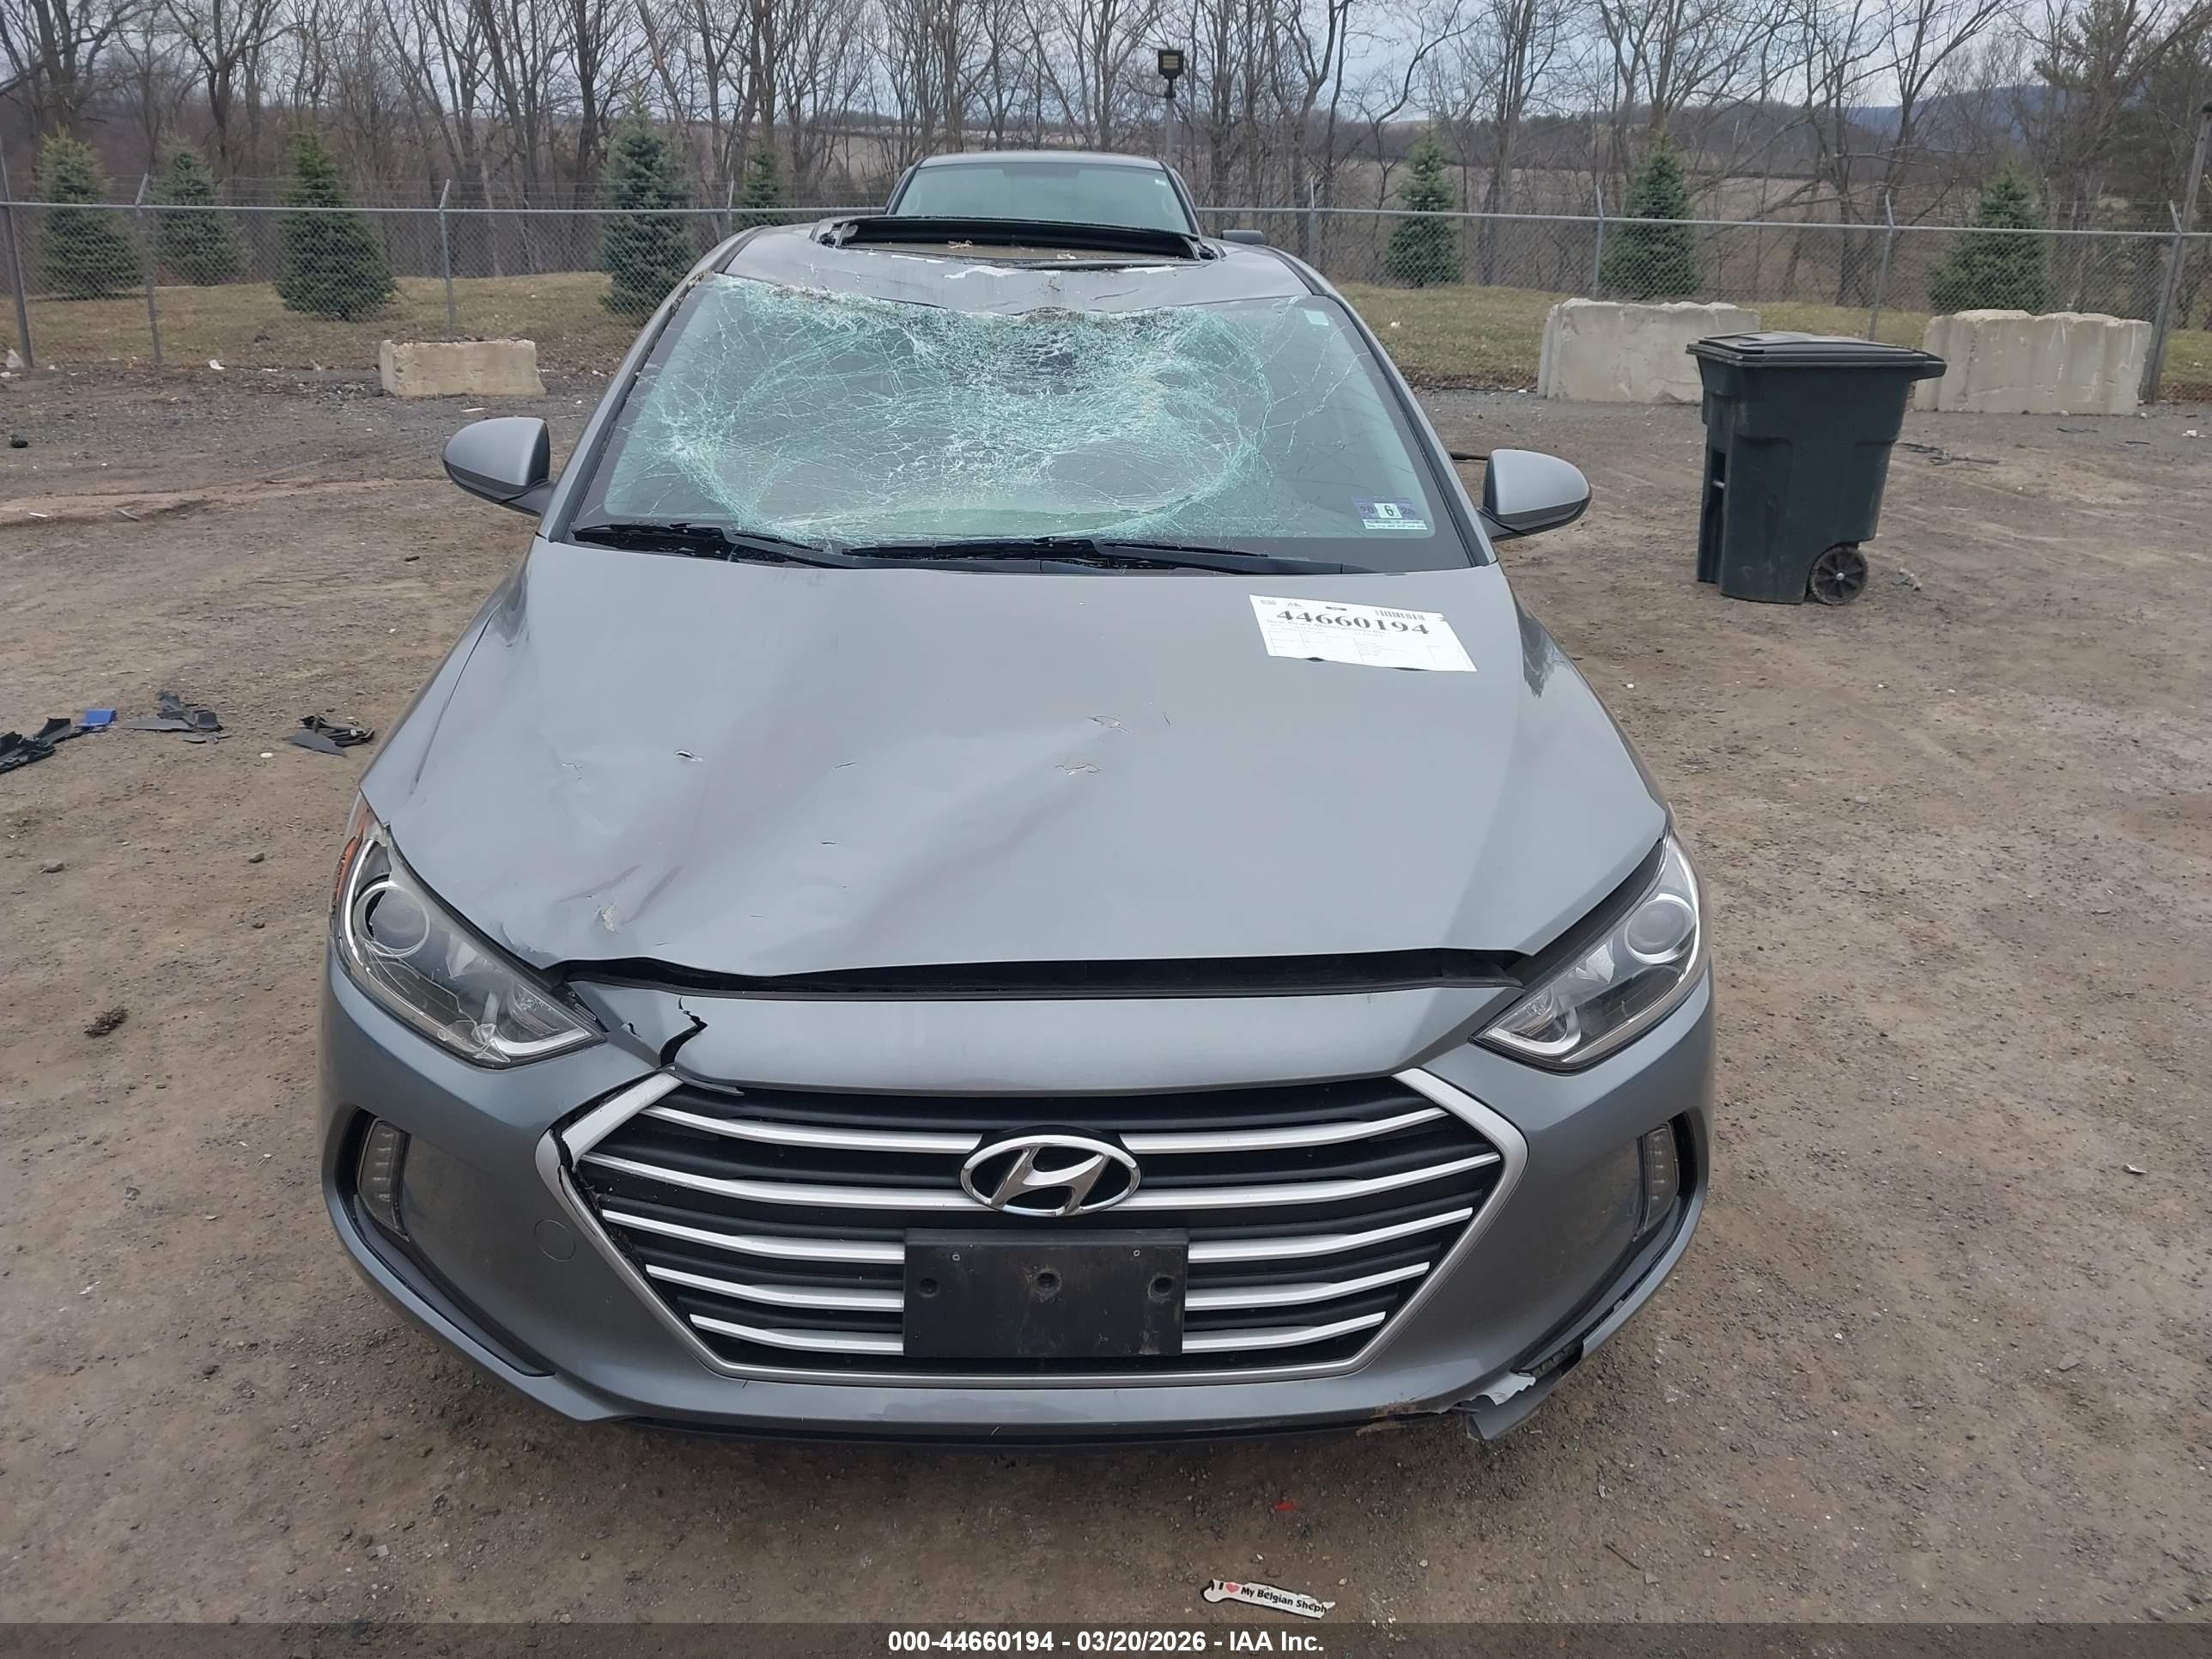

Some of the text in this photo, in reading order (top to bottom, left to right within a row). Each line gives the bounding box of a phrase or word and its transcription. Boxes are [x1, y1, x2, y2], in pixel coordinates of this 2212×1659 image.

[1384, 505, 1395, 517] 6
[1277, 610, 1430, 635] 44660194
[1218, 1582, 1224, 1590] I
[1240, 1586, 1255, 1598] My
[1256, 1589, 1293, 1605] Belgian
